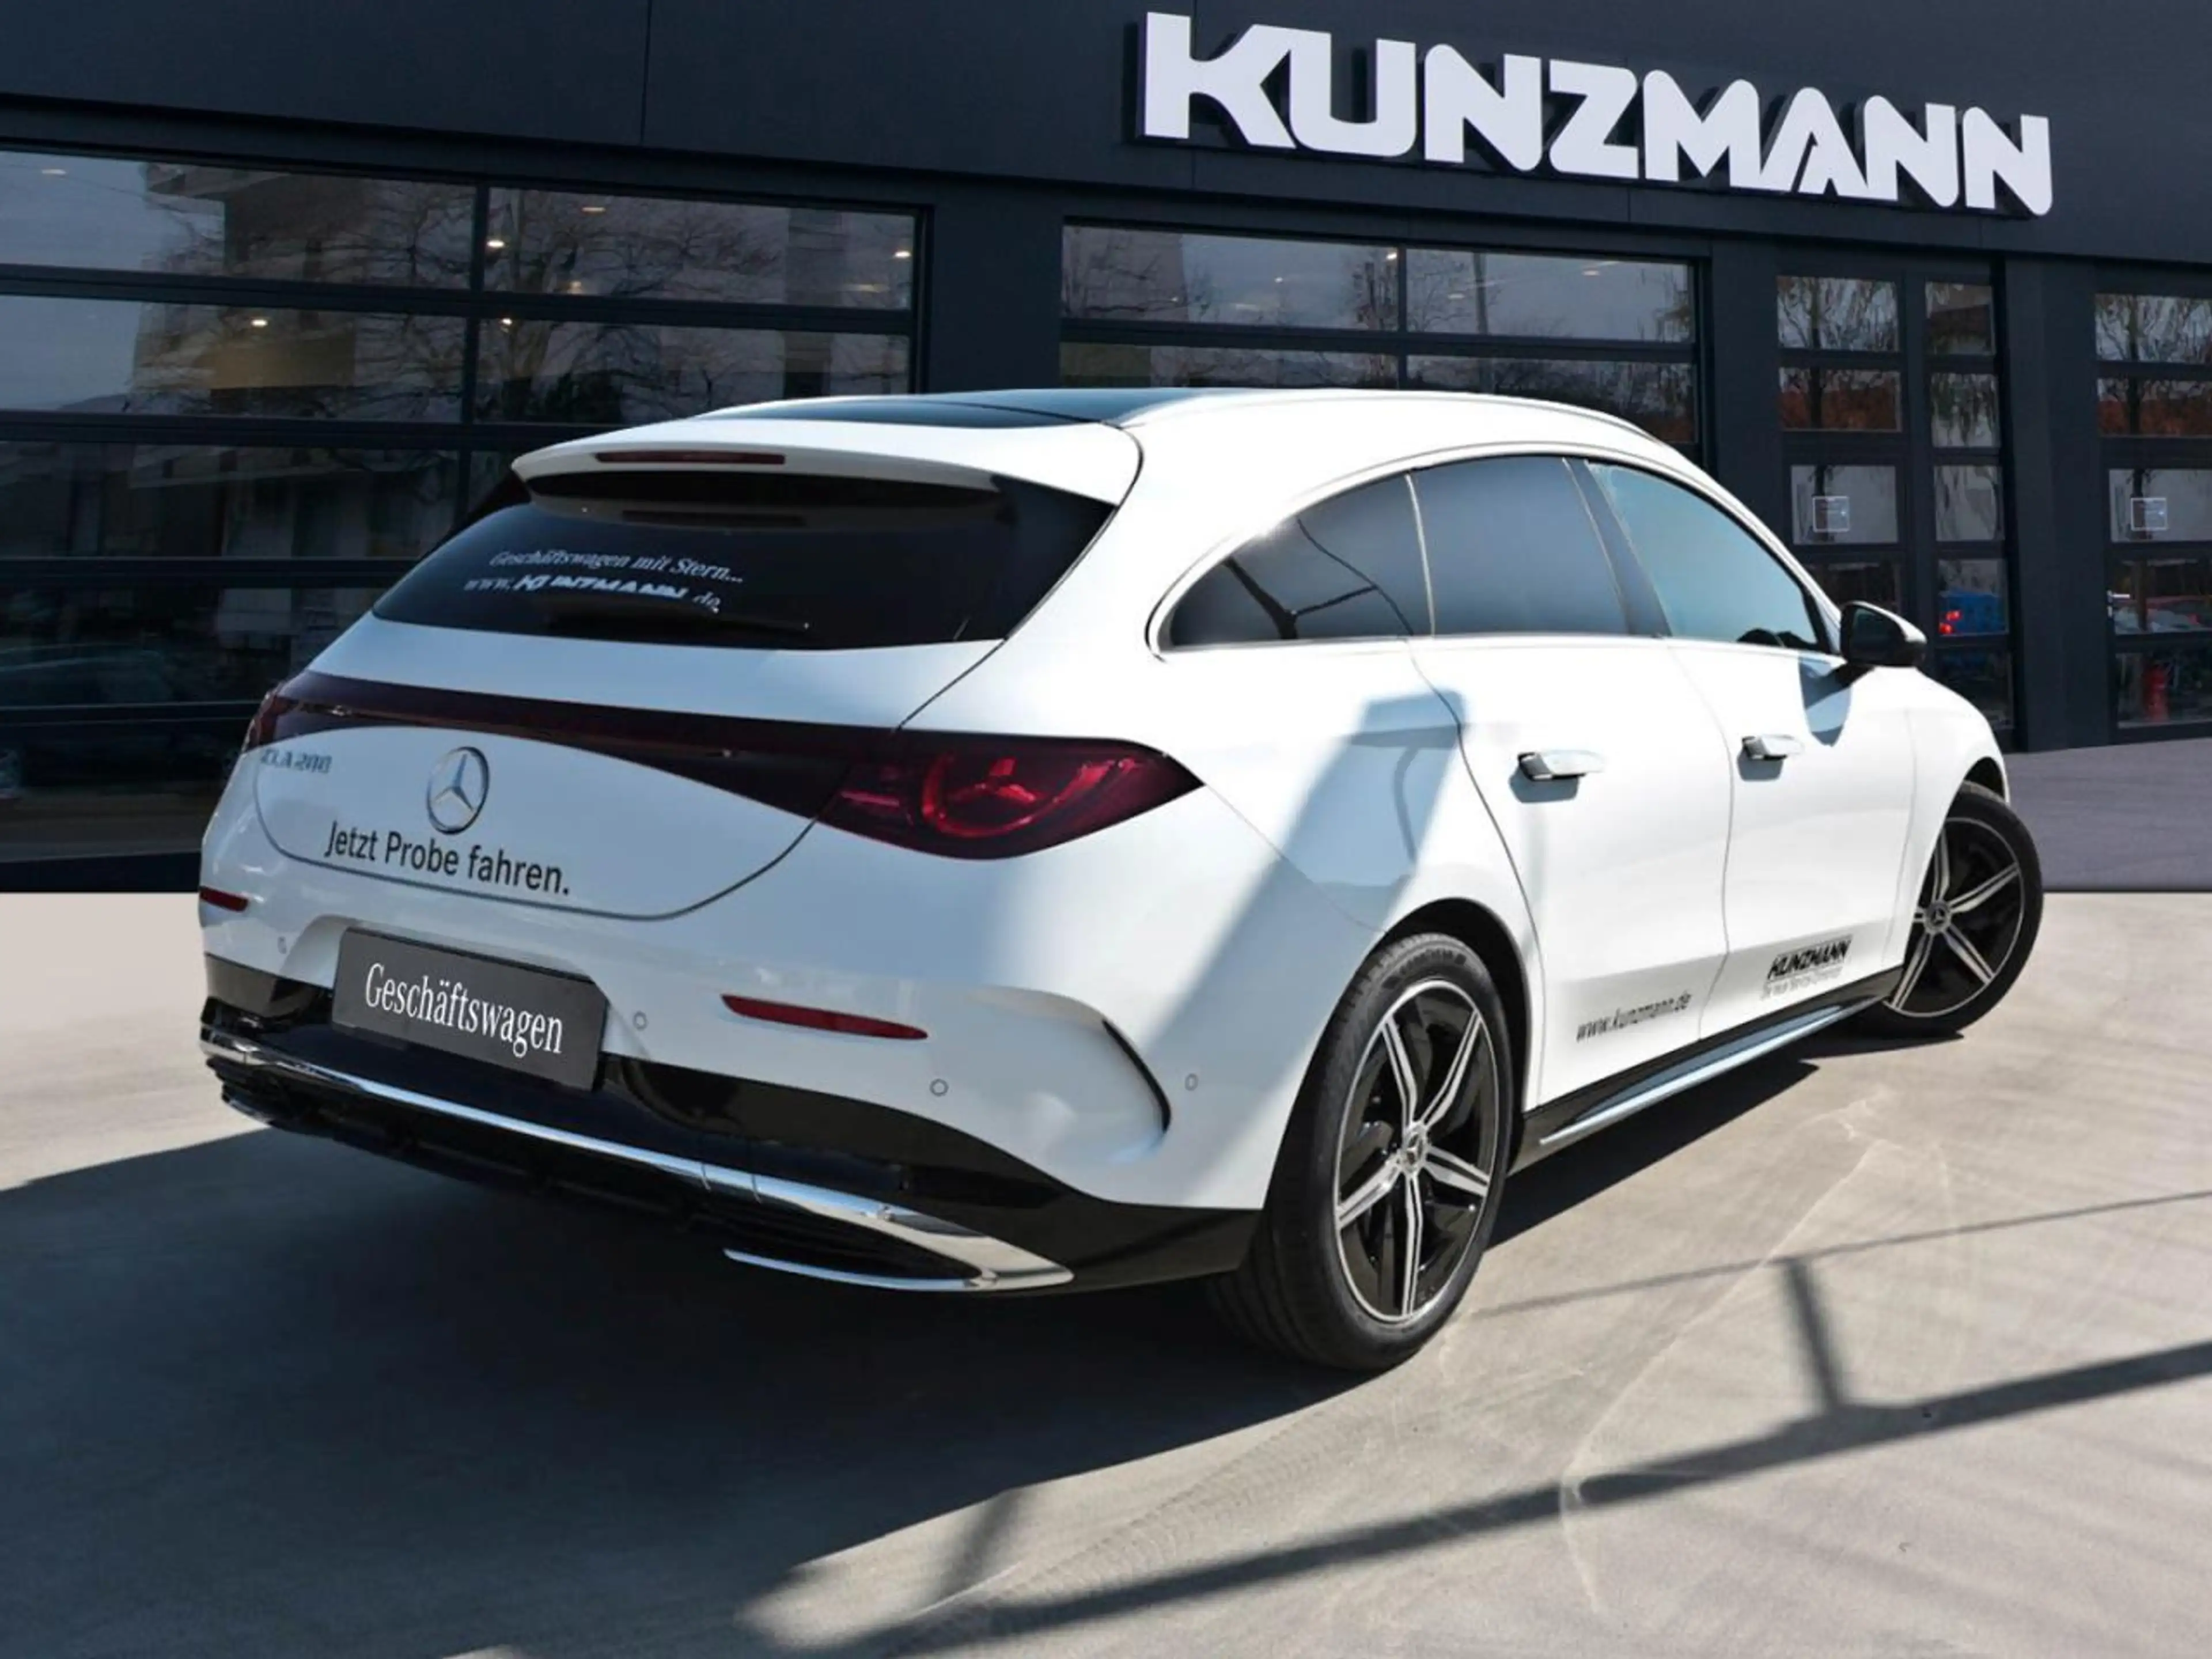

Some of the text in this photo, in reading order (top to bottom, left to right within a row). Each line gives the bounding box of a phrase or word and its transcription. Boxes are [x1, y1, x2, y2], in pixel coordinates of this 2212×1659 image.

[1144, 12, 2052, 215] KUNZMANN
[632, 555, 671, 571] mit
[324, 821, 570, 895] Jetzt Probe fahren.
[366, 963, 563, 1058] Geschäftswagen
